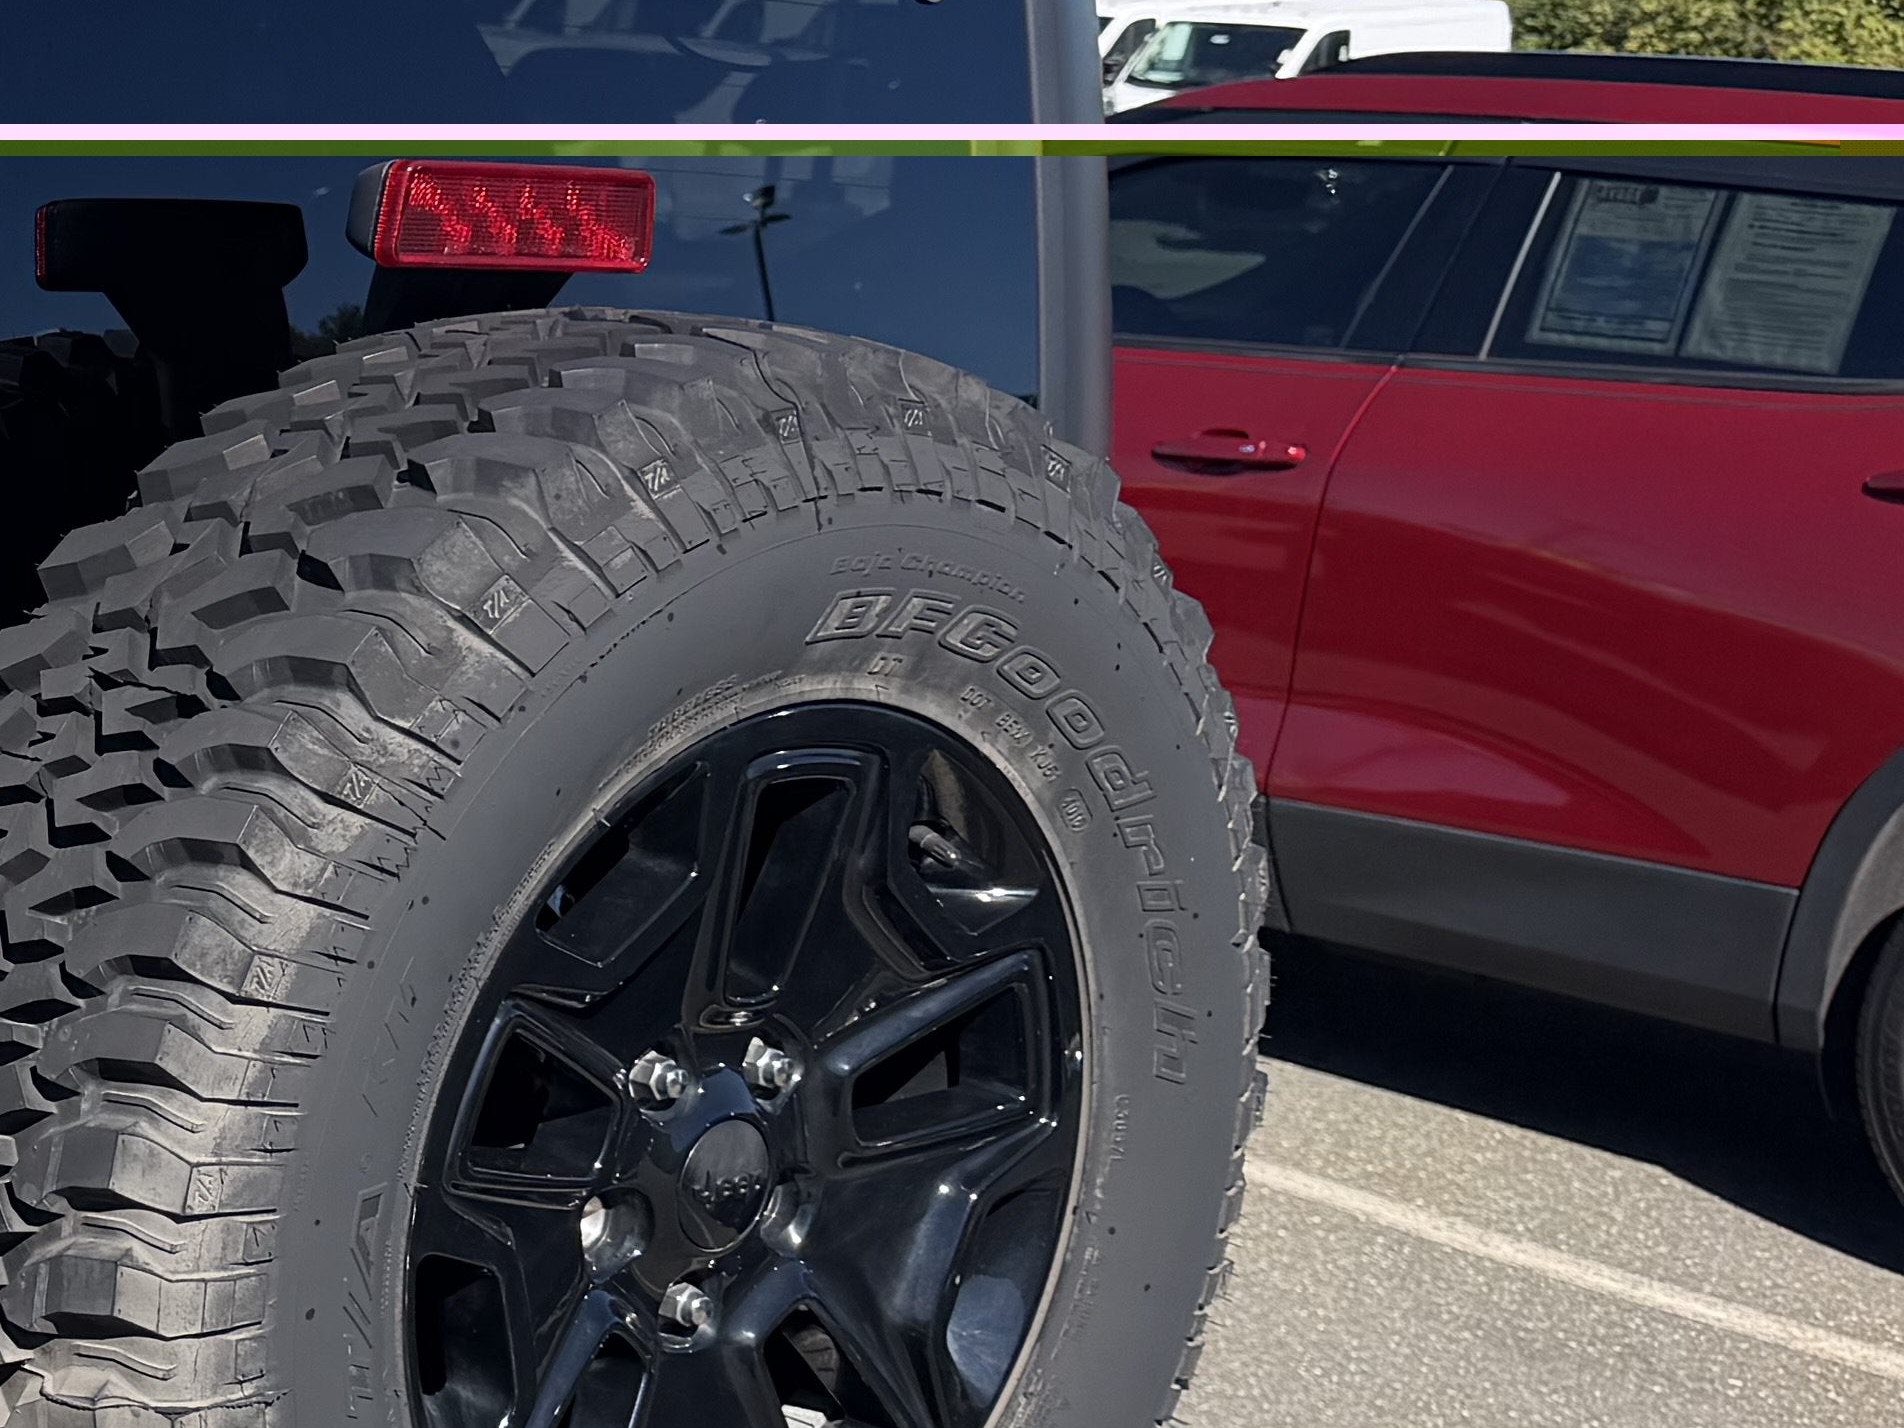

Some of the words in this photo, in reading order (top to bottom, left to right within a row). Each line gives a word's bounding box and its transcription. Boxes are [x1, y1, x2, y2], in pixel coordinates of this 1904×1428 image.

[900, 552, 1026, 605] Champion
[959, 686, 992, 710] DOT
[804, 587, 1198, 1086] BFGoodrich
